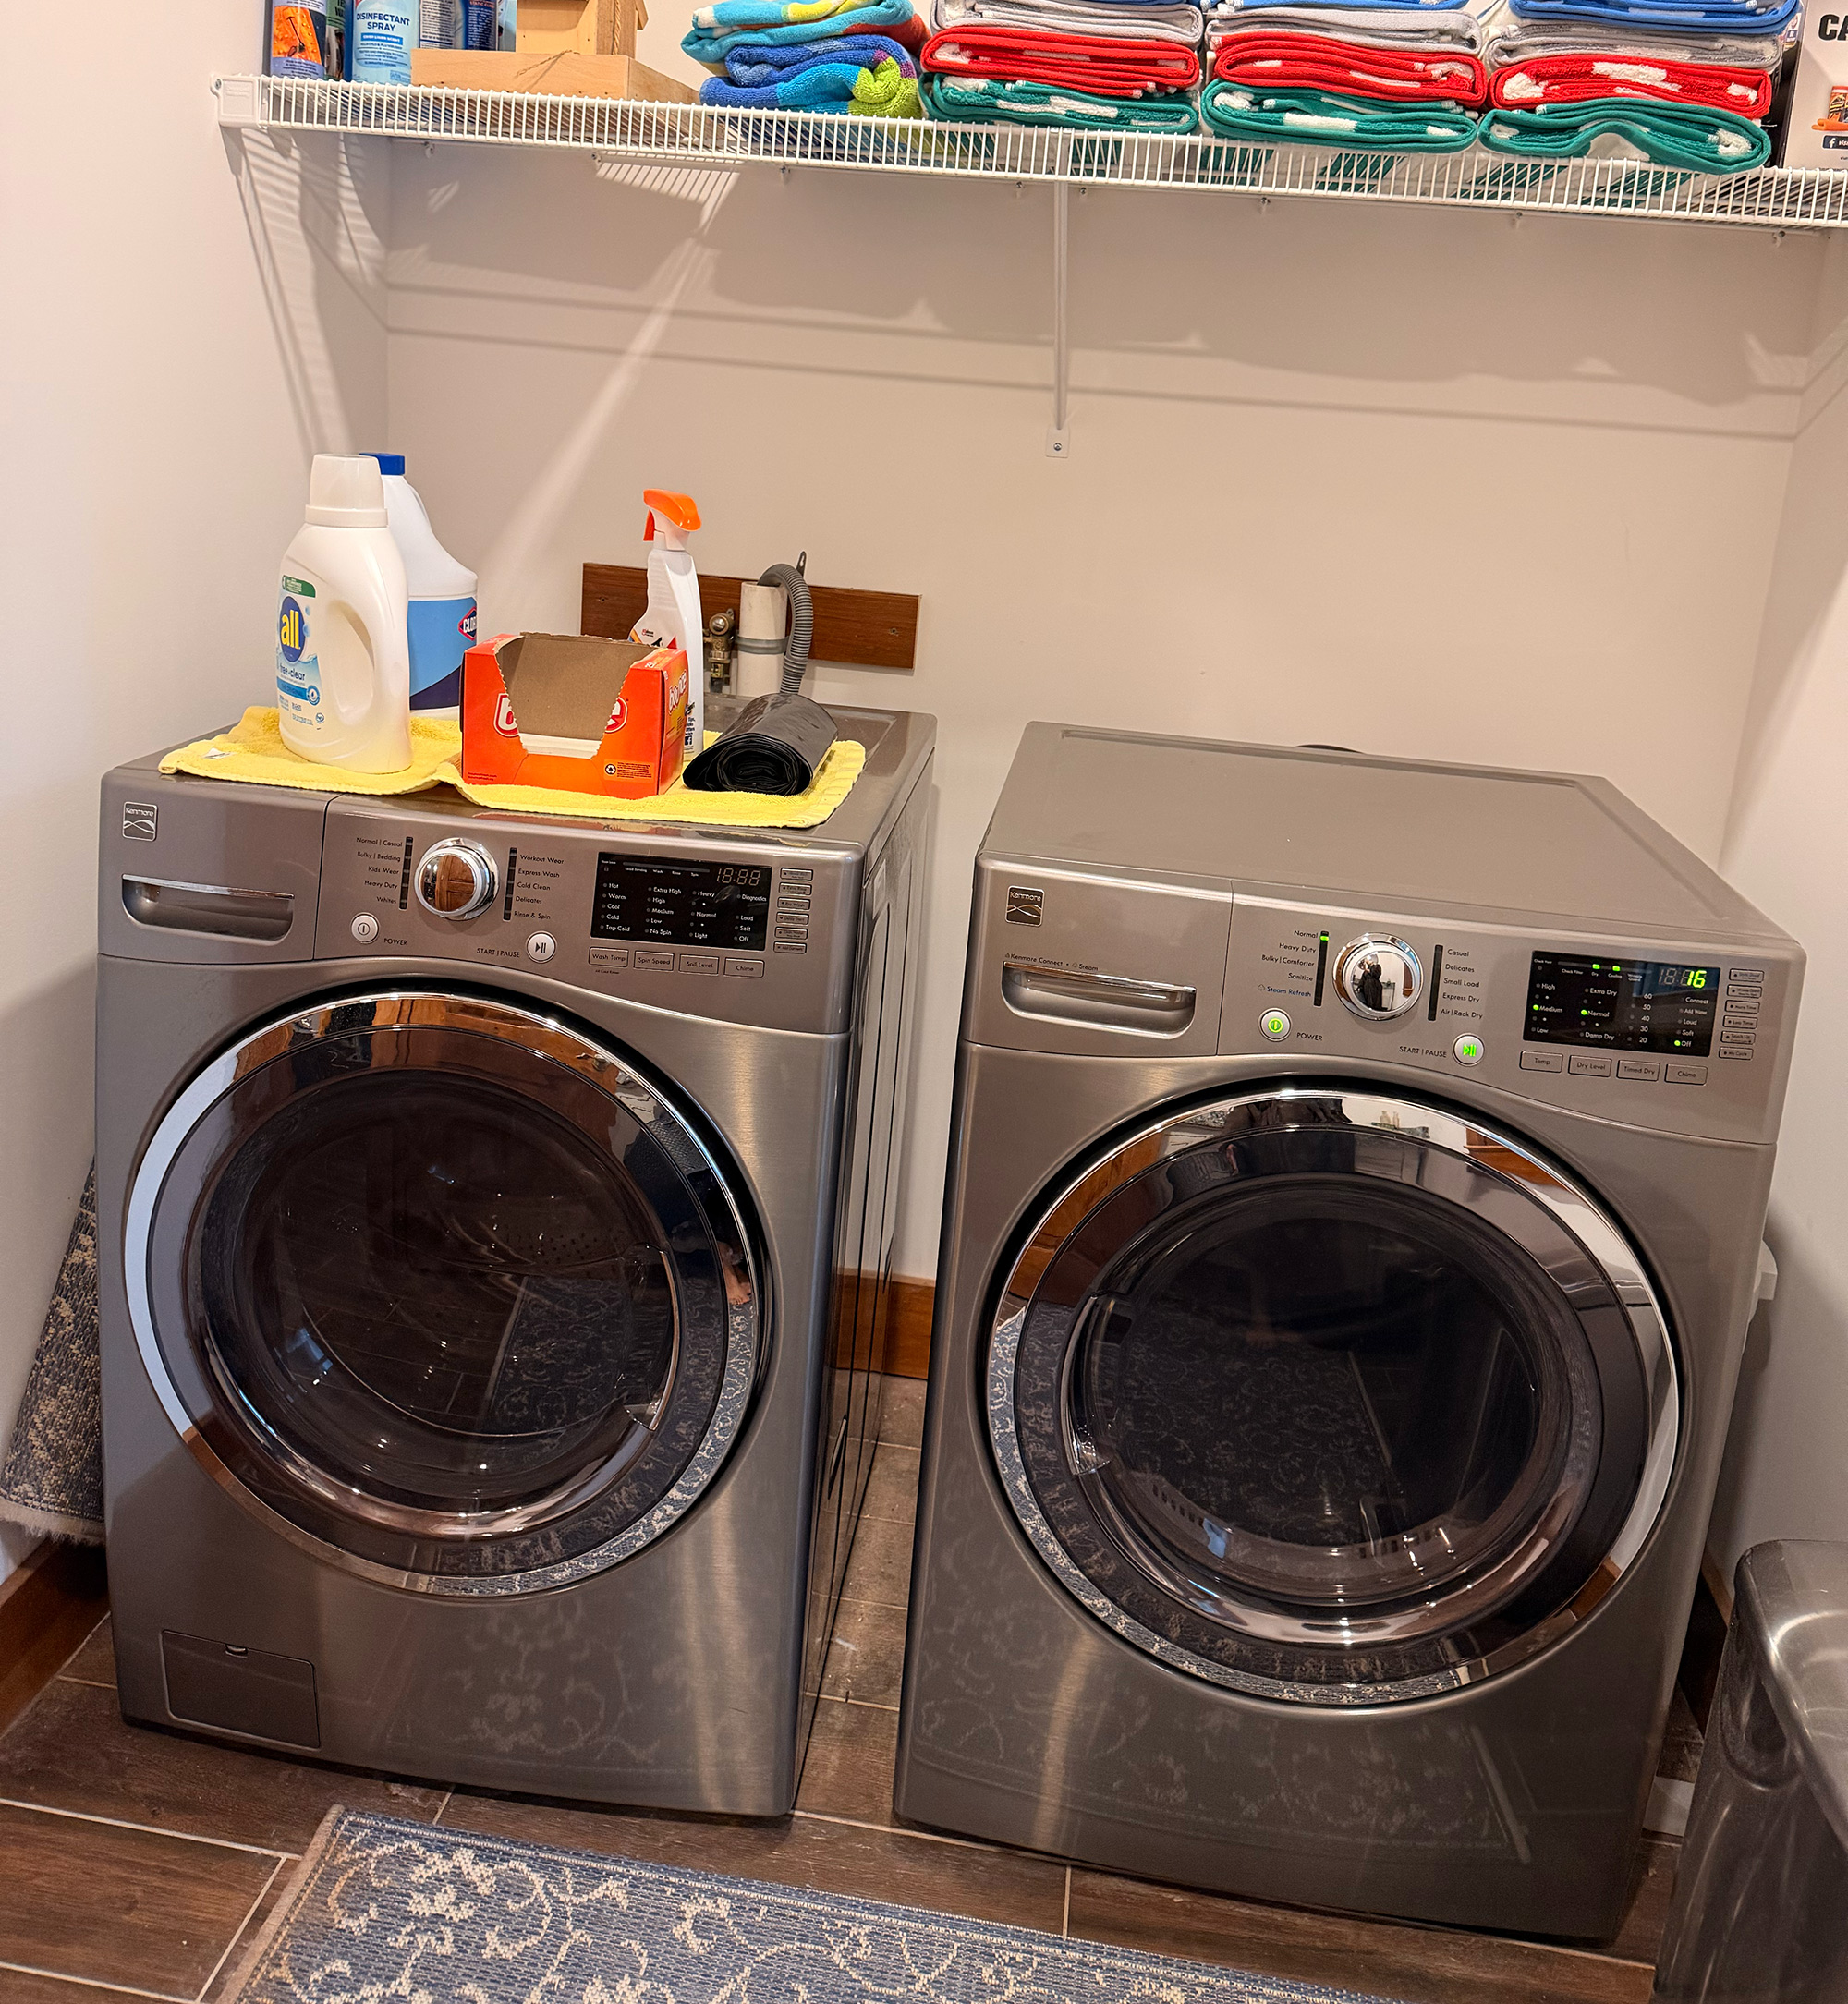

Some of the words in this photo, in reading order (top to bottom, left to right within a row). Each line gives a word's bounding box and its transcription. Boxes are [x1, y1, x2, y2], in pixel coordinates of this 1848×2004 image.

[357, 13, 410, 26] DISINFECTANT
[367, 22, 395, 31] SPRAY
[281, 610, 301, 650] all
[126, 808, 154, 817] Kenmore
[357, 837, 379, 845] Normal
[383, 839, 403, 847] Casual
[357, 852, 372, 861] Bulky
[376, 854, 401, 863] Bedding
[520, 854, 546, 863] Workout
[368, 866, 383, 874] Kids
[518, 868, 541, 878] Express
[364, 880, 383, 889] Heavy
[517, 881, 531, 890] Cold
[653, 886, 668, 894] Extra
[669, 888, 682, 896] High
[698, 890, 715, 898] Heavy
[516, 896, 542, 905] Delicates
[653, 897, 666, 905] High
[742, 894, 767, 903] Diagnostics
[1010, 891, 1041, 902] Kenmore
[538, 913, 551, 921] Spin
[606, 924, 616, 932] Tap
[1294, 930, 1319, 939] Normal
[384, 938, 407, 946] POWER
[1279, 942, 1298, 952] Heavy
[1300, 946, 1317, 954] Duty
[477, 948, 496, 956] START
[501, 950, 520, 958] PAUSE
[1447, 949, 1469, 957] Casual
[1011, 953, 1037, 963] Kenmore
[1039, 957, 1063, 966] Connect
[1445, 964, 1475, 973] Delicates
[1288, 973, 1314, 982] Sanitize
[1443, 978, 1462, 986] Small
[1464, 979, 1479, 988] Load
[1541, 983, 1556, 991] High
[1267, 986, 1287, 995] Steam
[1288, 988, 1311, 998] Refresh
[1442, 992, 1467, 1002] Express
[1468, 996, 1479, 1004] Dry
[1685, 996, 1709, 1005] Connect
[1539, 1005, 1563, 1014] Medium
[1587, 1009, 1610, 1018] Normal
[1473, 1012, 1483, 1020] Dry
[1297, 1033, 1323, 1041] POWER
[1585, 1031, 1602, 1040] Damp
[1603, 1033, 1615, 1041] Dry
[1399, 1046, 1419, 1055] START
[1426, 1049, 1447, 1058] PAUSE
[1535, 1058, 1551, 1067] Temp
[1577, 1062, 1589, 1070] Dry
[1624, 1066, 1643, 1075] Timed
[1644, 1068, 1656, 1076] Dry
[1677, 1071, 1696, 1079] Chime
